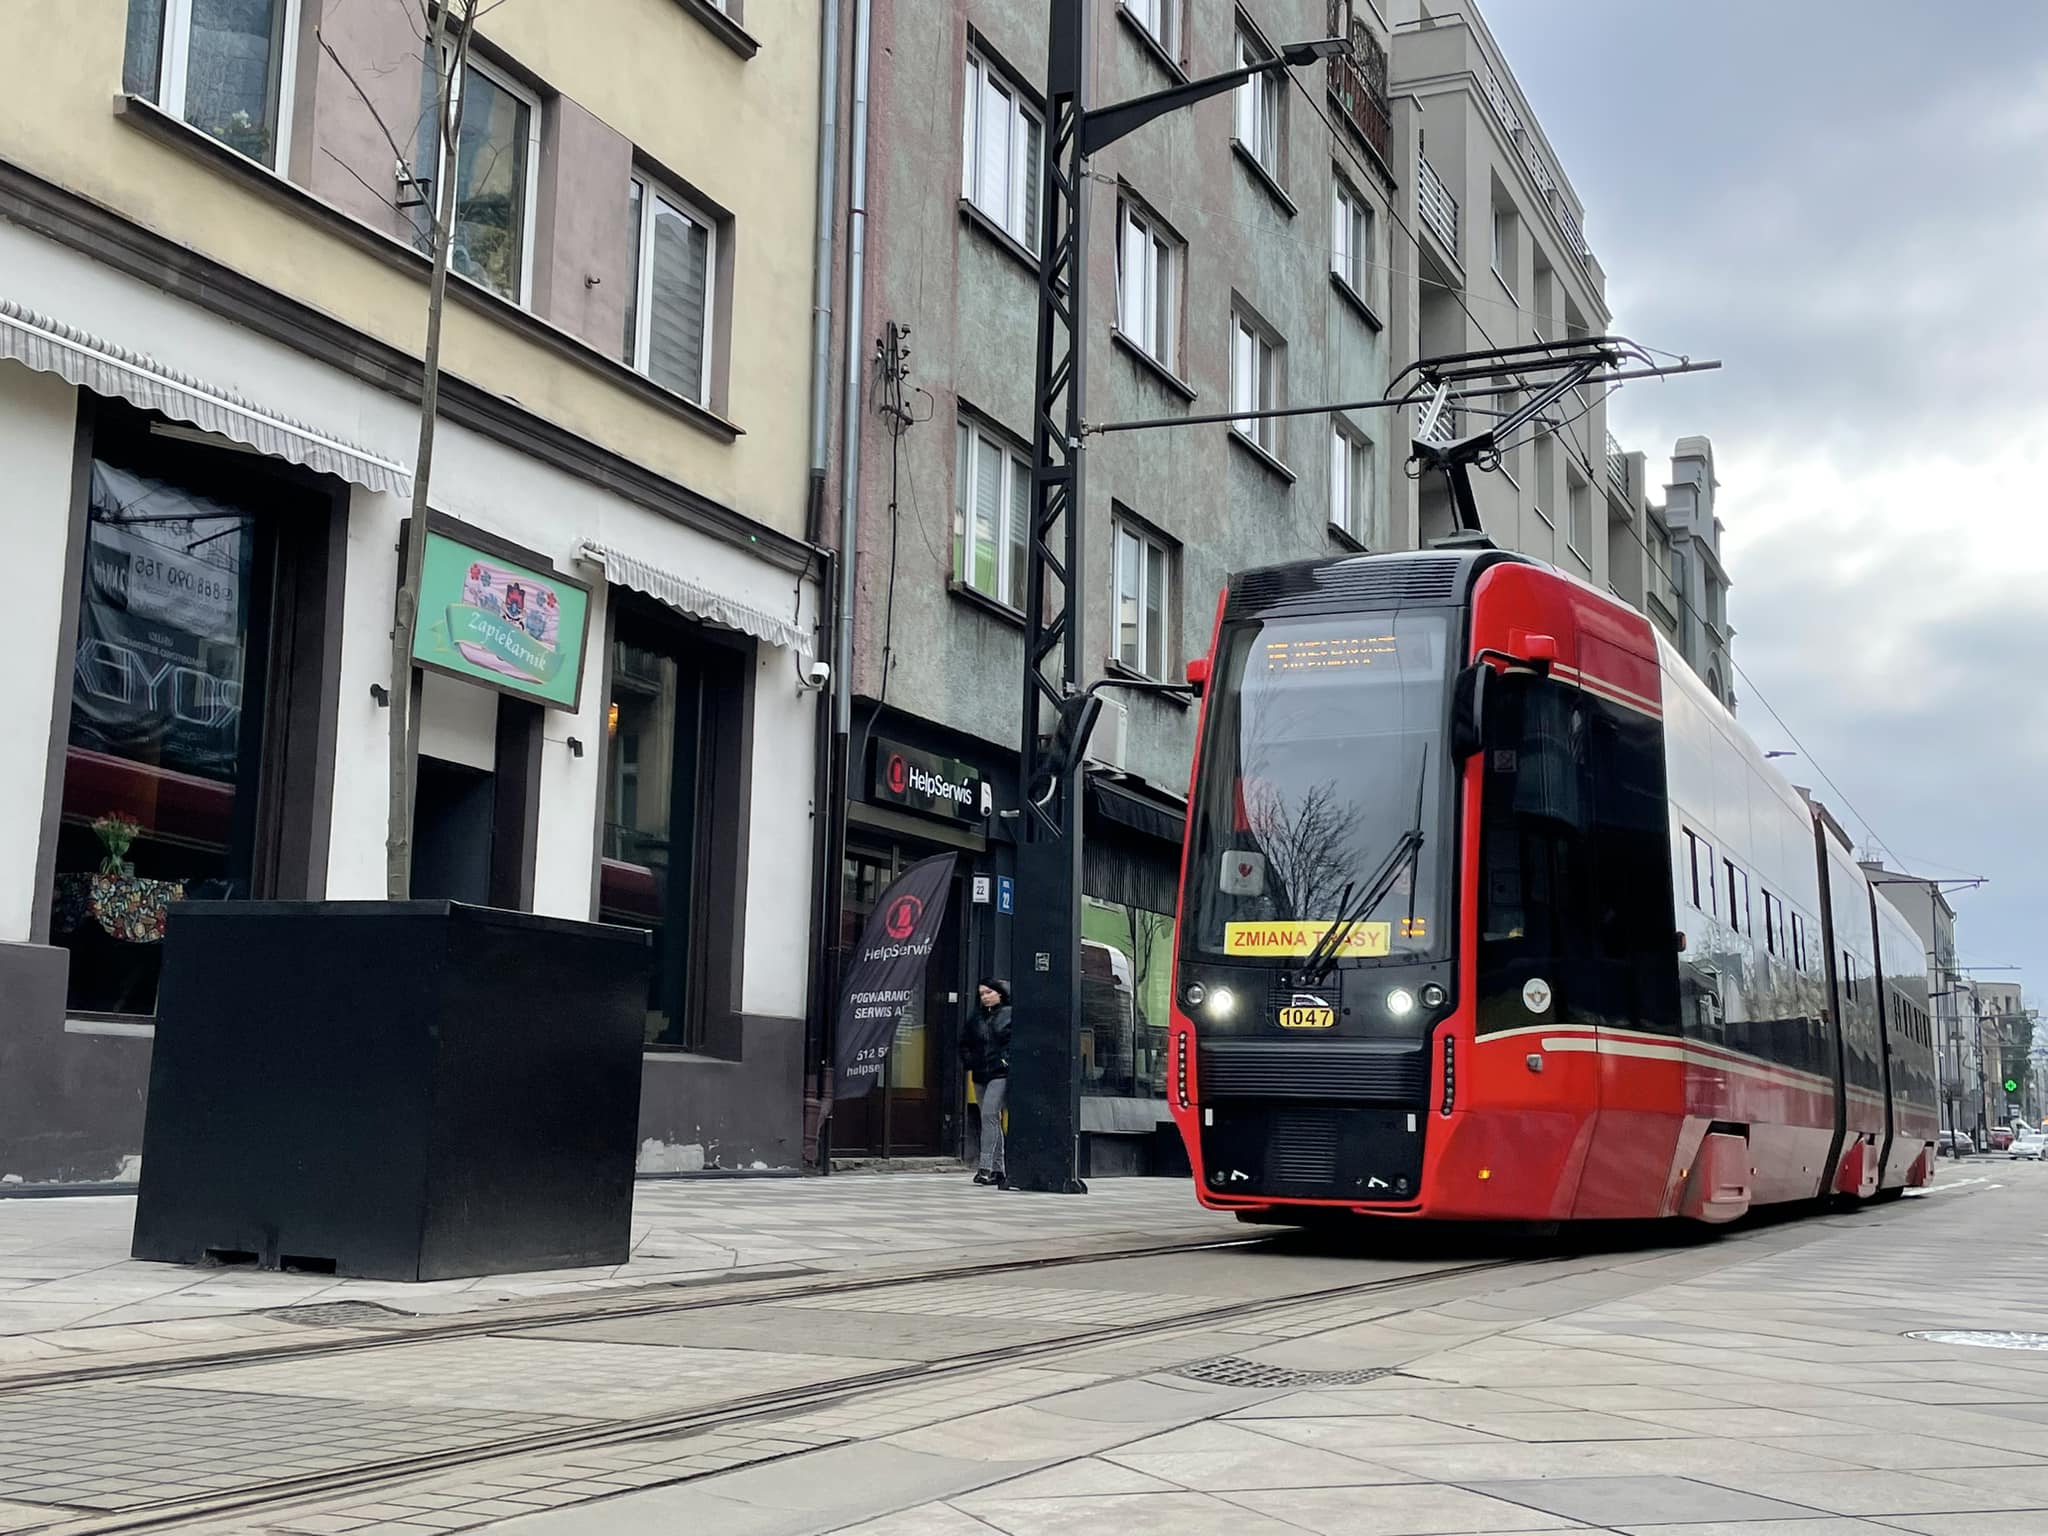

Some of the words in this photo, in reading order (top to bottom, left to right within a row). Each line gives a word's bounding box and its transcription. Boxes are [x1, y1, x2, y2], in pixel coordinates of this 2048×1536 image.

[468, 611, 546, 671] Zapiekarnik
[909, 766, 973, 805] HelpSerwis
[976, 886, 985, 895] 22
[1234, 931, 1307, 947] ZMIANA
[850, 989, 913, 1004] POGWARANC
[855, 1006, 892, 1019] SERWIS
[894, 1006, 904, 1016] A
[1283, 1009, 1330, 1026] 1047
[857, 1048, 875, 1061] 512
[847, 1064, 881, 1077] helpse
